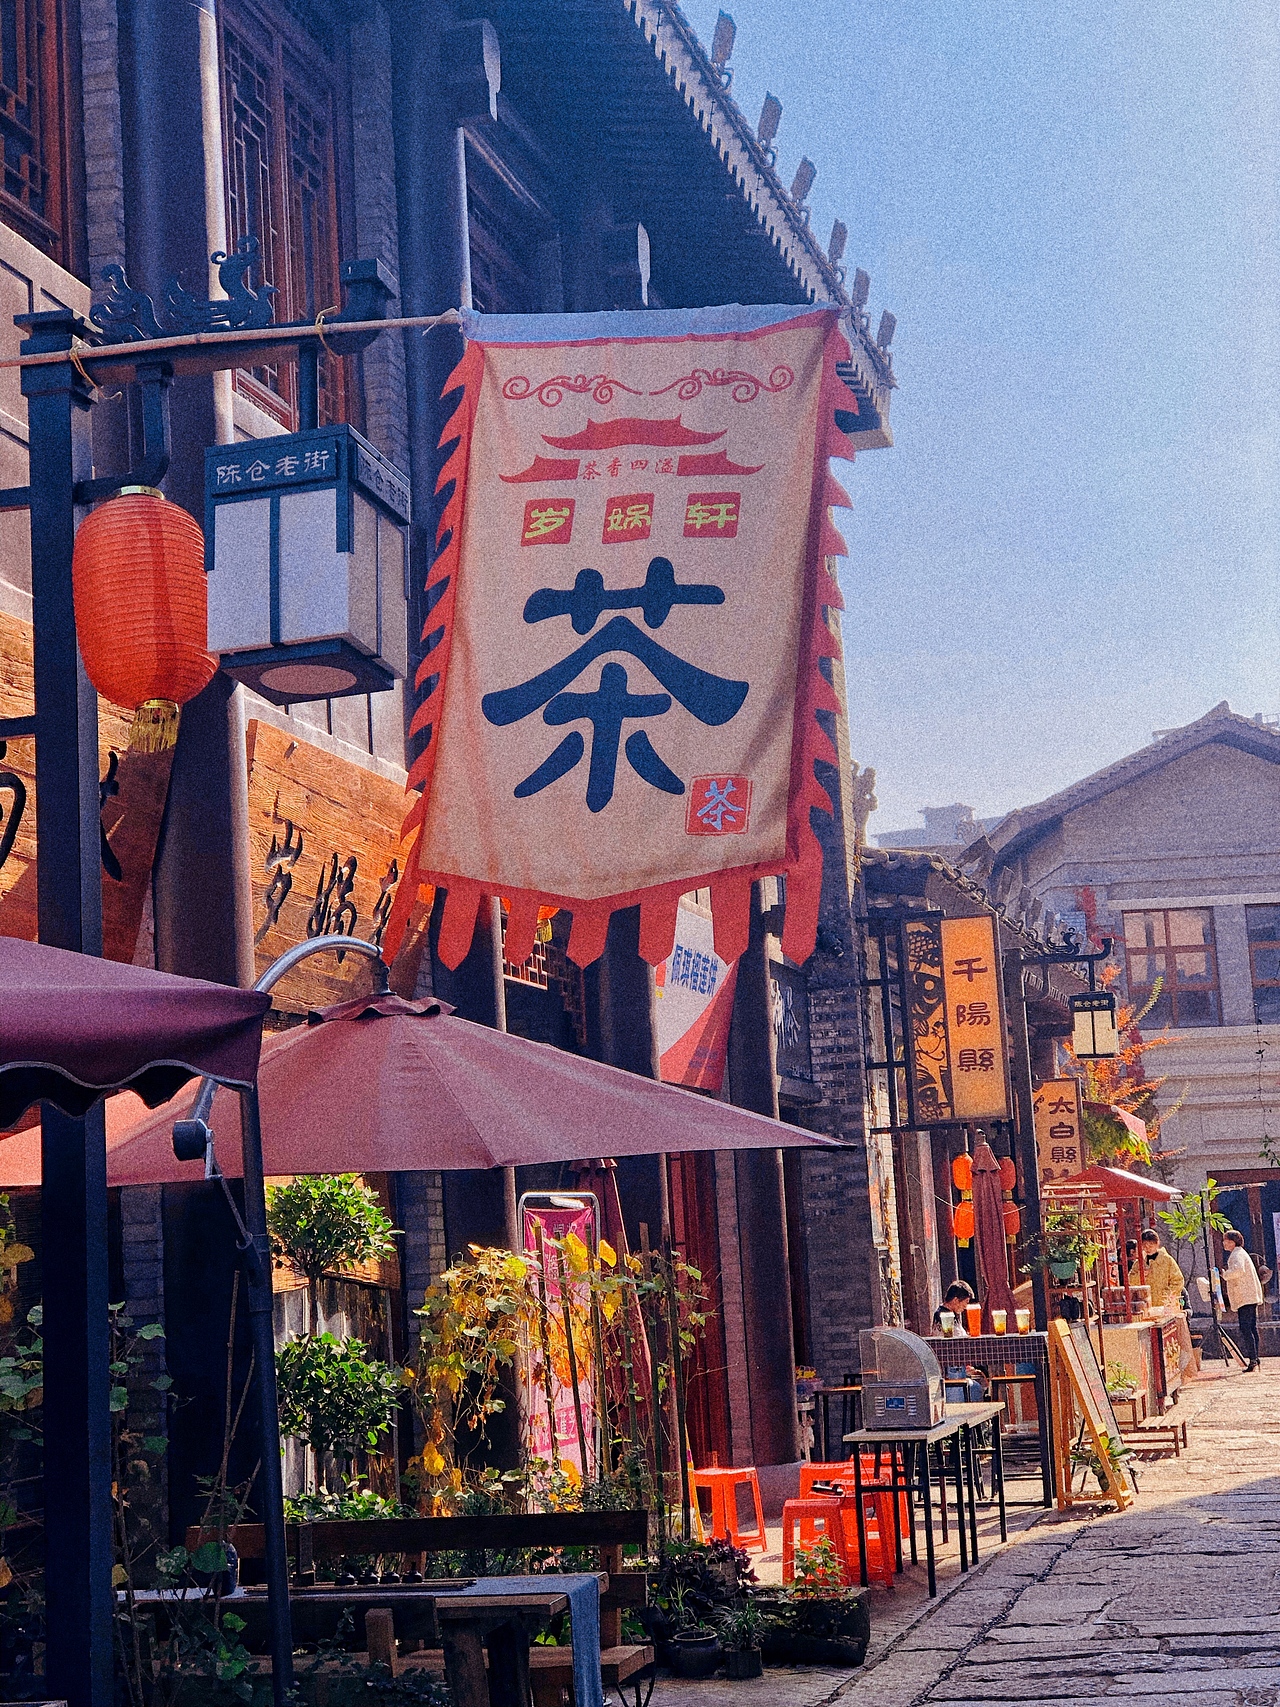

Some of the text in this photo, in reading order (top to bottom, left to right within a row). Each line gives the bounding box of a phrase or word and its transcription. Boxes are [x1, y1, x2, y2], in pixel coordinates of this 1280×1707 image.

[216, 448, 330, 486] 陈仓老街
[579, 457, 677, 480] 茶香四溢
[481, 557, 750, 813] 茶
[697, 779, 745, 831] 茶
[951, 956, 995, 1073] 千陽縣
[1048, 1096, 1078, 1164] 太白縣
